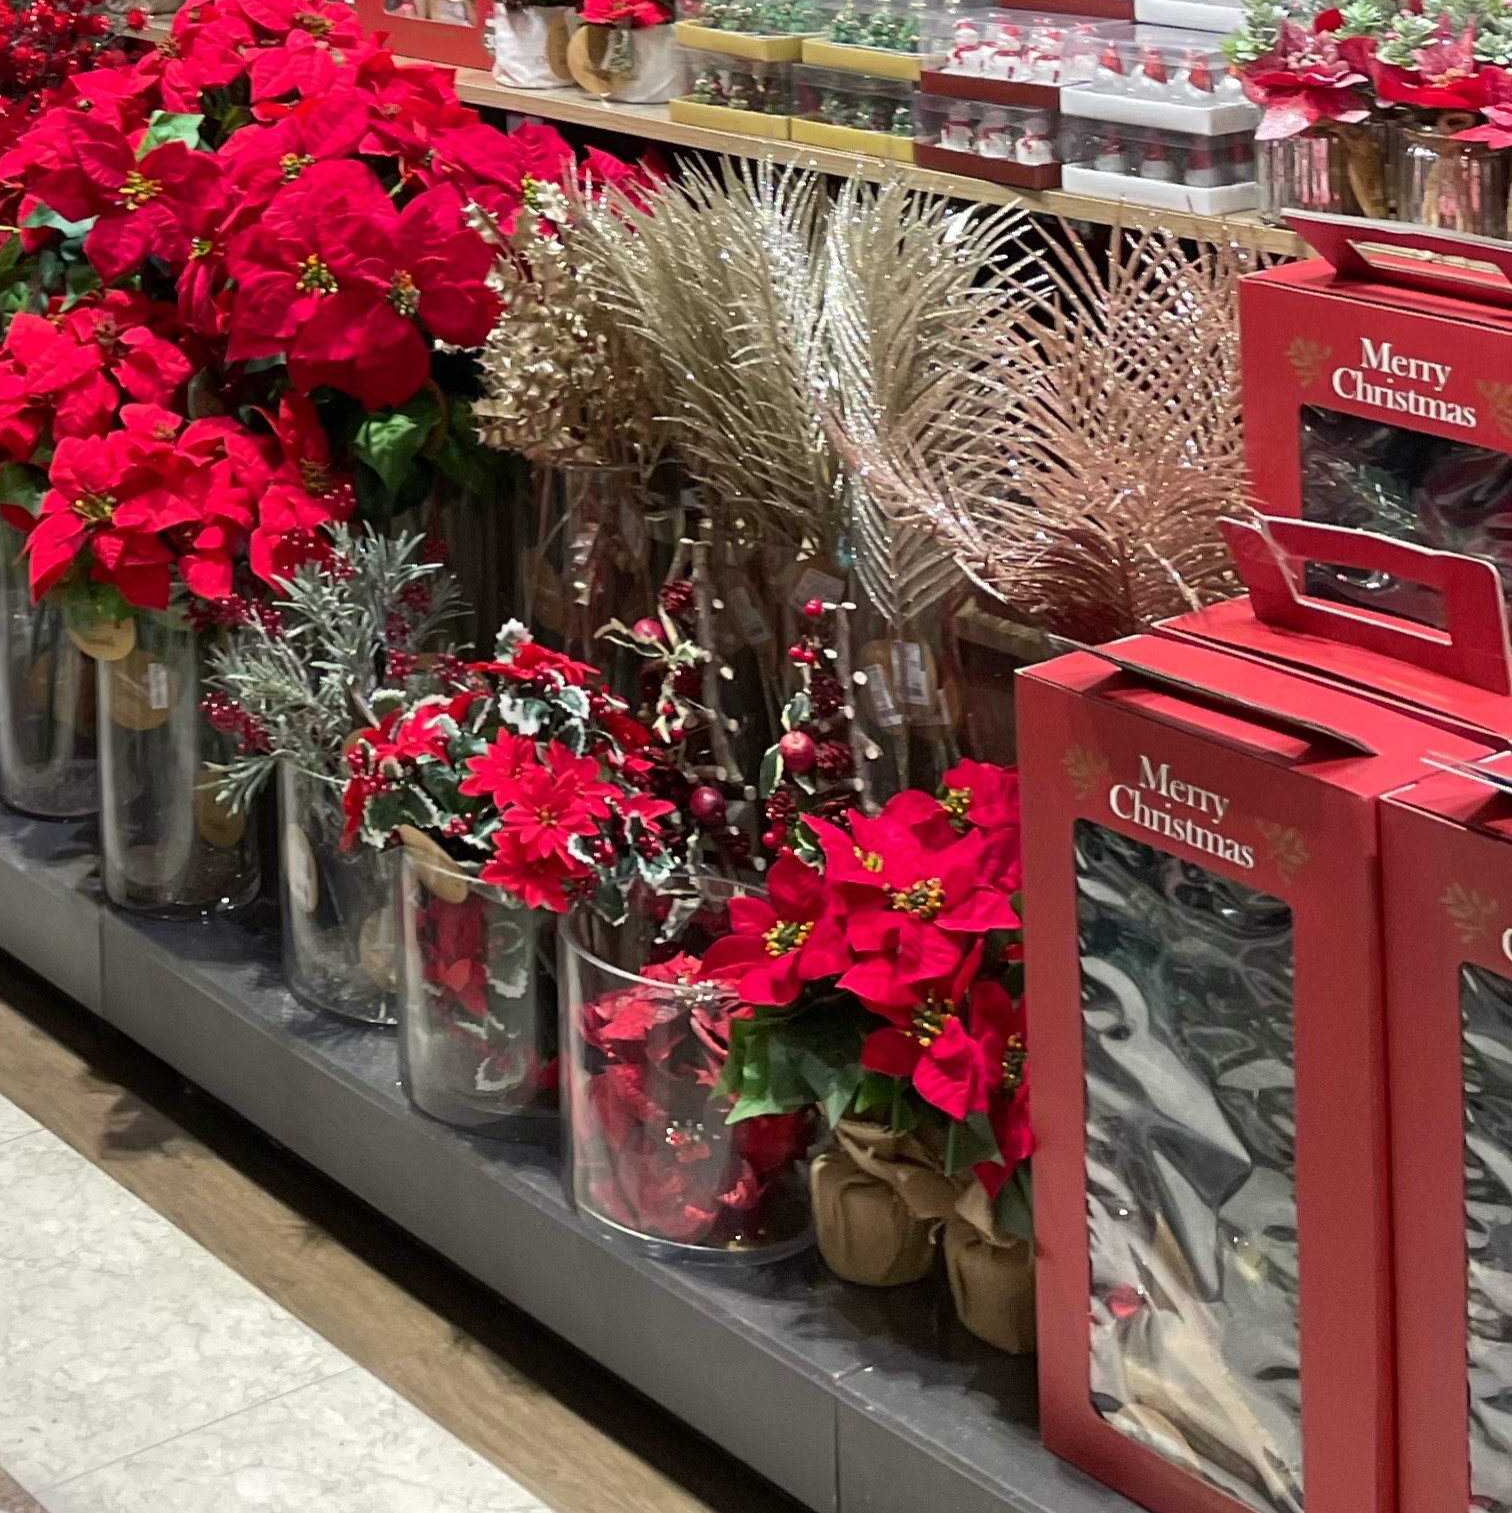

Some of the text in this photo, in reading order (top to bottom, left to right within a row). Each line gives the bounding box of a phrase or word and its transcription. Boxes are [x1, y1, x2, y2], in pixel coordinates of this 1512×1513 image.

[1331, 366, 1477, 428] Christmas
[1360, 336, 1453, 392] Merry
[1138, 754, 1229, 825] Merry
[1109, 784, 1255, 869] Christmas
